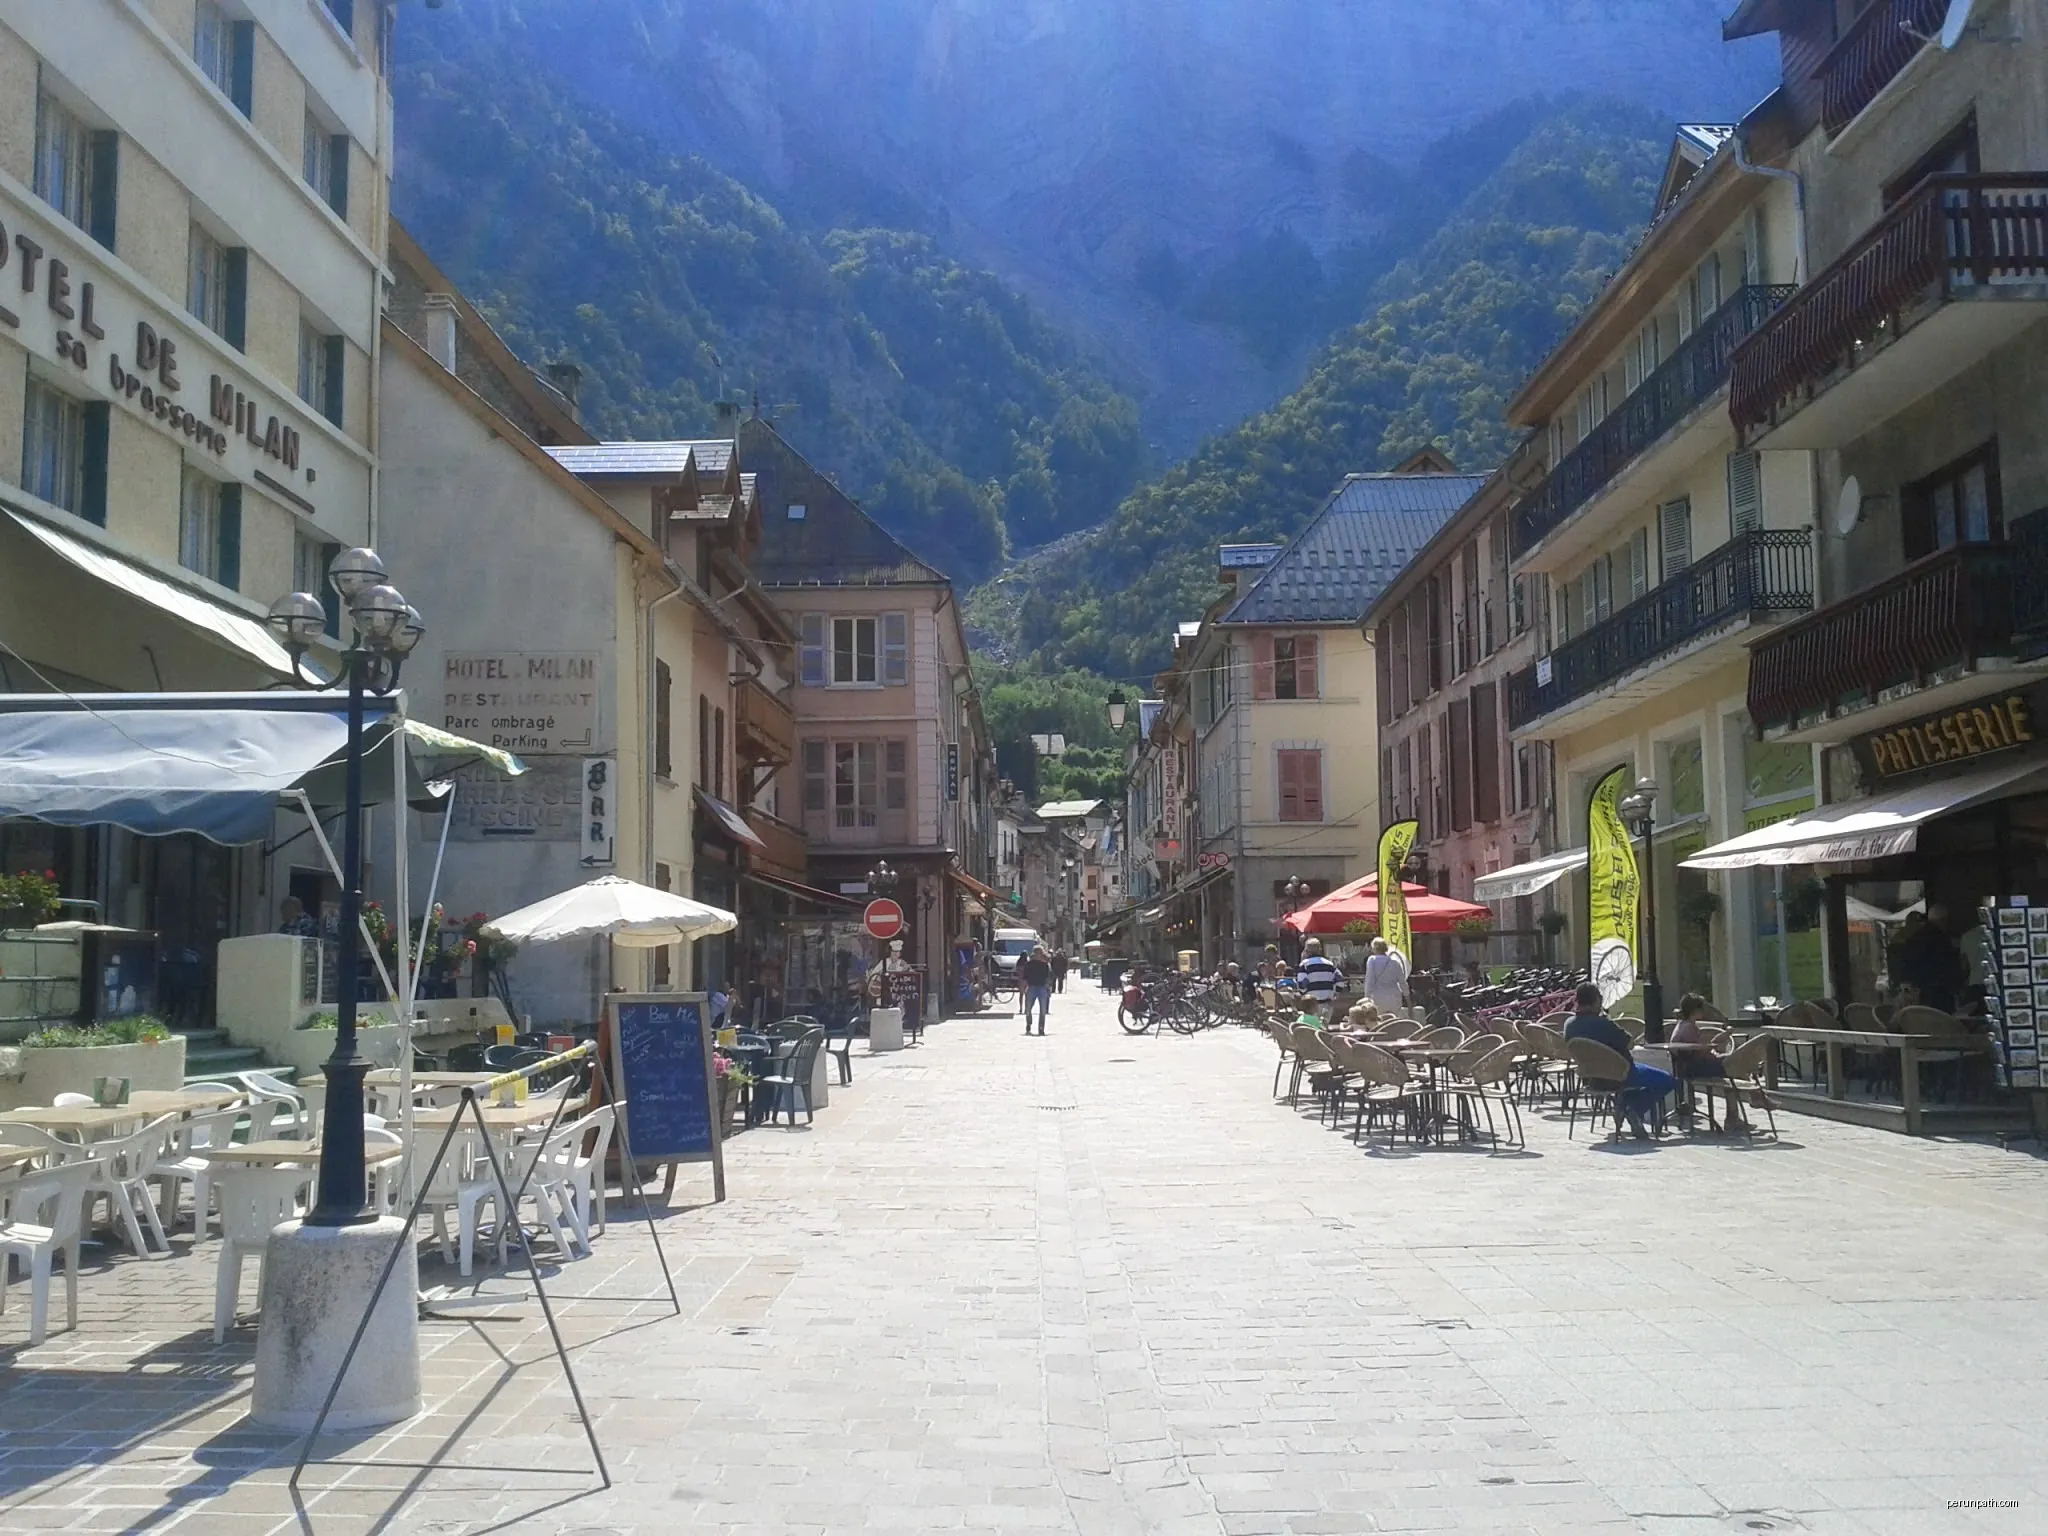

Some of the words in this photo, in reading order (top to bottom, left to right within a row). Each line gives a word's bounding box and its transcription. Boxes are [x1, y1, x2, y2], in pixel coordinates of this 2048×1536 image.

[0, 219, 104, 340] TEL
[137, 321, 181, 391] DE
[110, 353, 227, 456] brasserie
[446, 658, 508, 679] HOTEL
[528, 658, 593, 680] MILAN
[445, 715, 479, 729] Parc
[491, 714, 555, 731] ombragé
[1870, 696, 2034, 776] PATISSERIE
[1165, 750, 1176, 831] RESTAURANT
